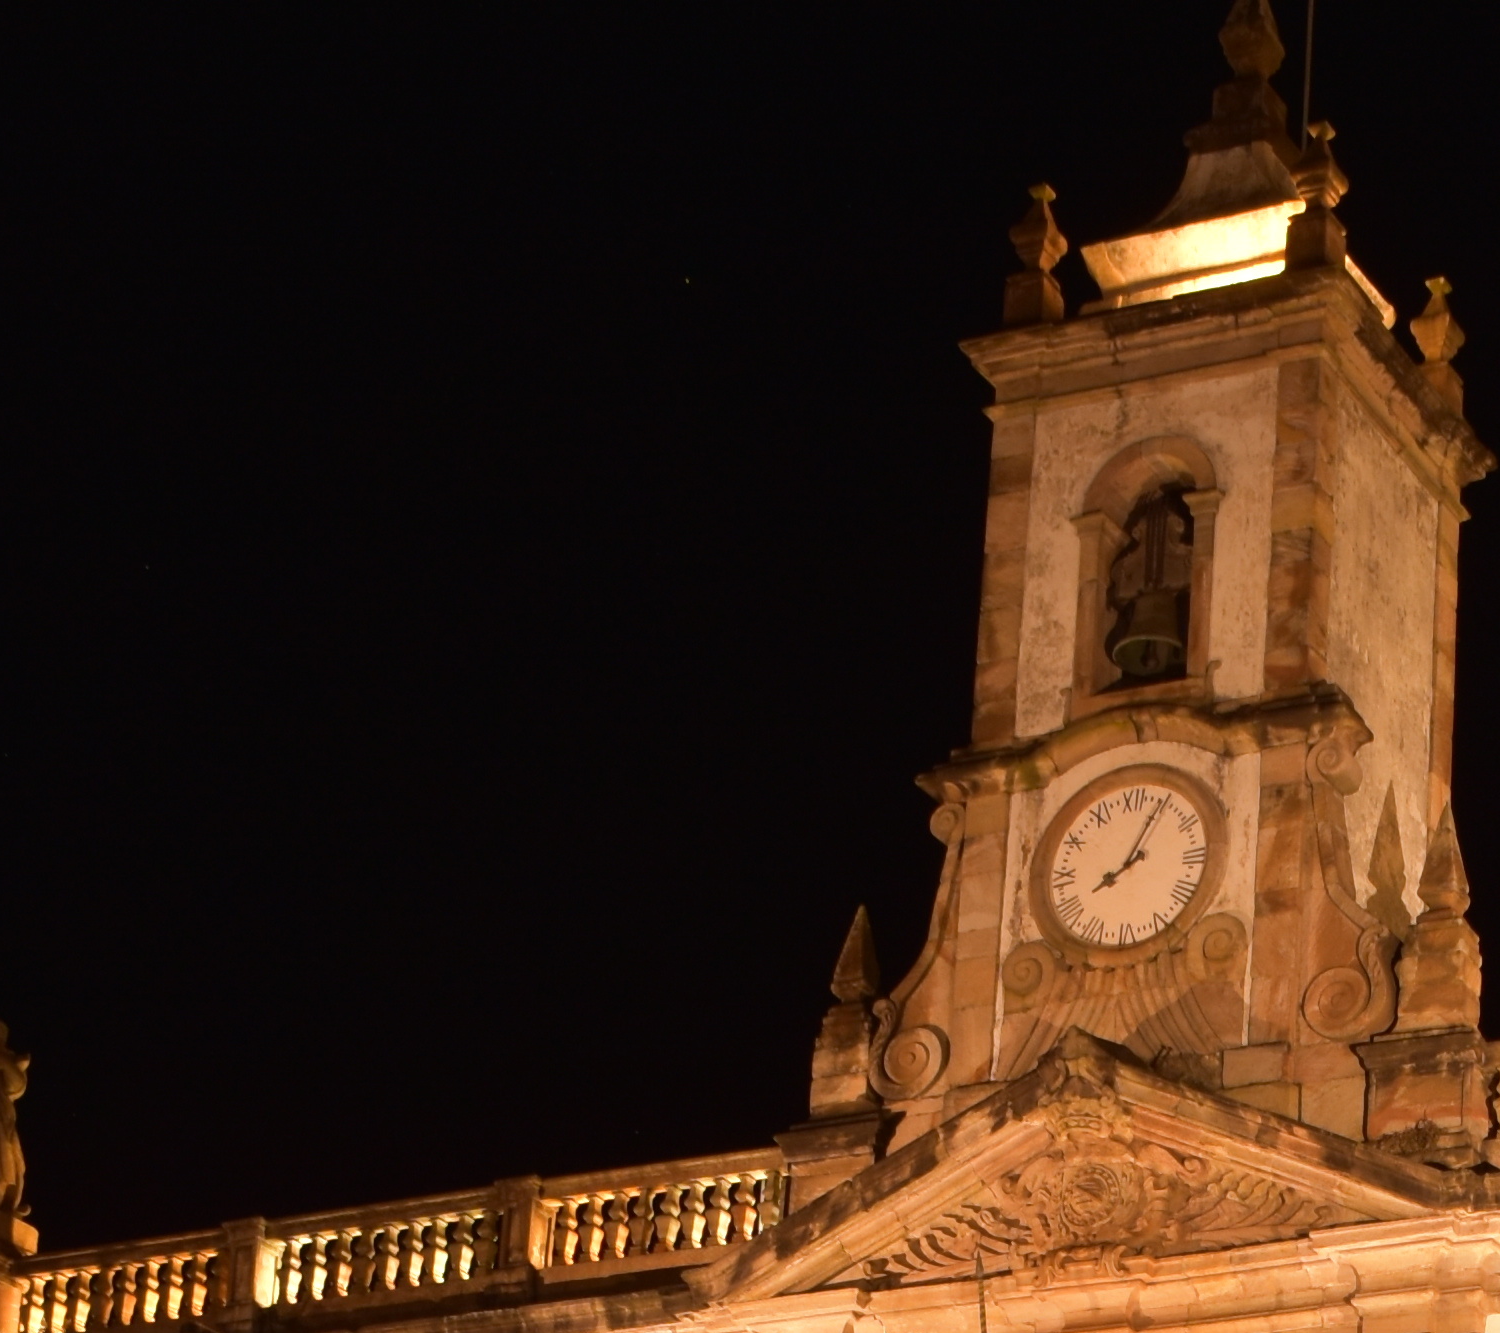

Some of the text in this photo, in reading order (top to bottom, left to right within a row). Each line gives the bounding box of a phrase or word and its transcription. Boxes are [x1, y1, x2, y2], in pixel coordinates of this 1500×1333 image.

[1122, 787, 1146, 814] XII
[1089, 800, 1112, 828] XI
[1177, 813, 1199, 833] II
[1063, 831, 1086, 852] X
[1182, 847, 1206, 865] III
[1152, 911, 1170, 934] V
[1118, 923, 1137, 946] VI
